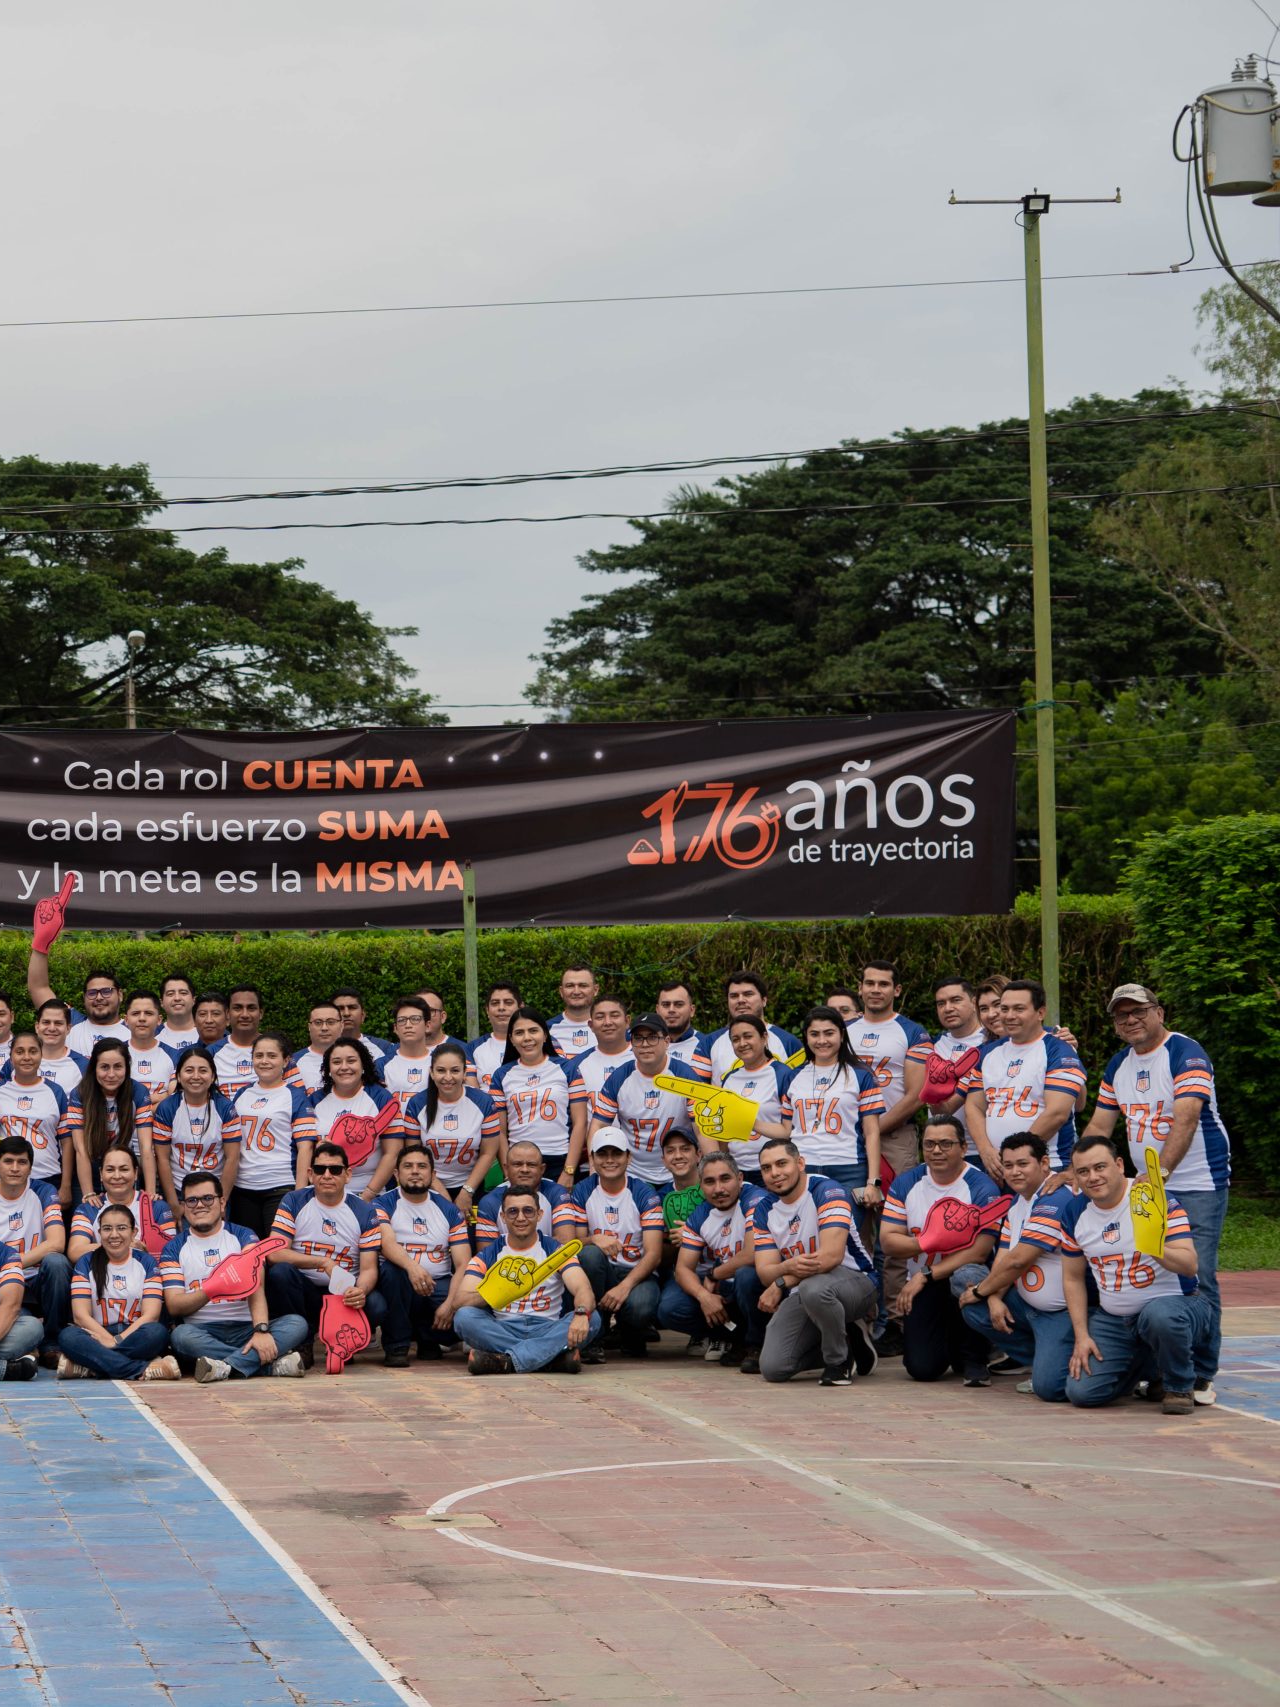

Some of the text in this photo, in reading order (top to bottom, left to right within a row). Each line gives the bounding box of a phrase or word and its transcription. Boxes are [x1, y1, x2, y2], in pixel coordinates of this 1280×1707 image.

[64, 759, 424, 790] Cada rol CUENTA
[785, 760, 975, 831] años
[27, 809, 450, 842] cada esfuerzo SUMA
[788, 834, 974, 866] de trayectoria
[17, 860, 464, 900] y la meta es la MISMA
[510, 1088, 557, 1124] 176
[794, 1097, 842, 1134] 176
[985, 1086, 1038, 1118] 176
[0, 1115, 48, 1149] 176
[175, 1142, 218, 1171] 176
[426, 1137, 475, 1165] 176
[398, 1242, 446, 1264] 76
[1090, 1251, 1155, 1291] 176
[97, 1298, 141, 1327] 176
